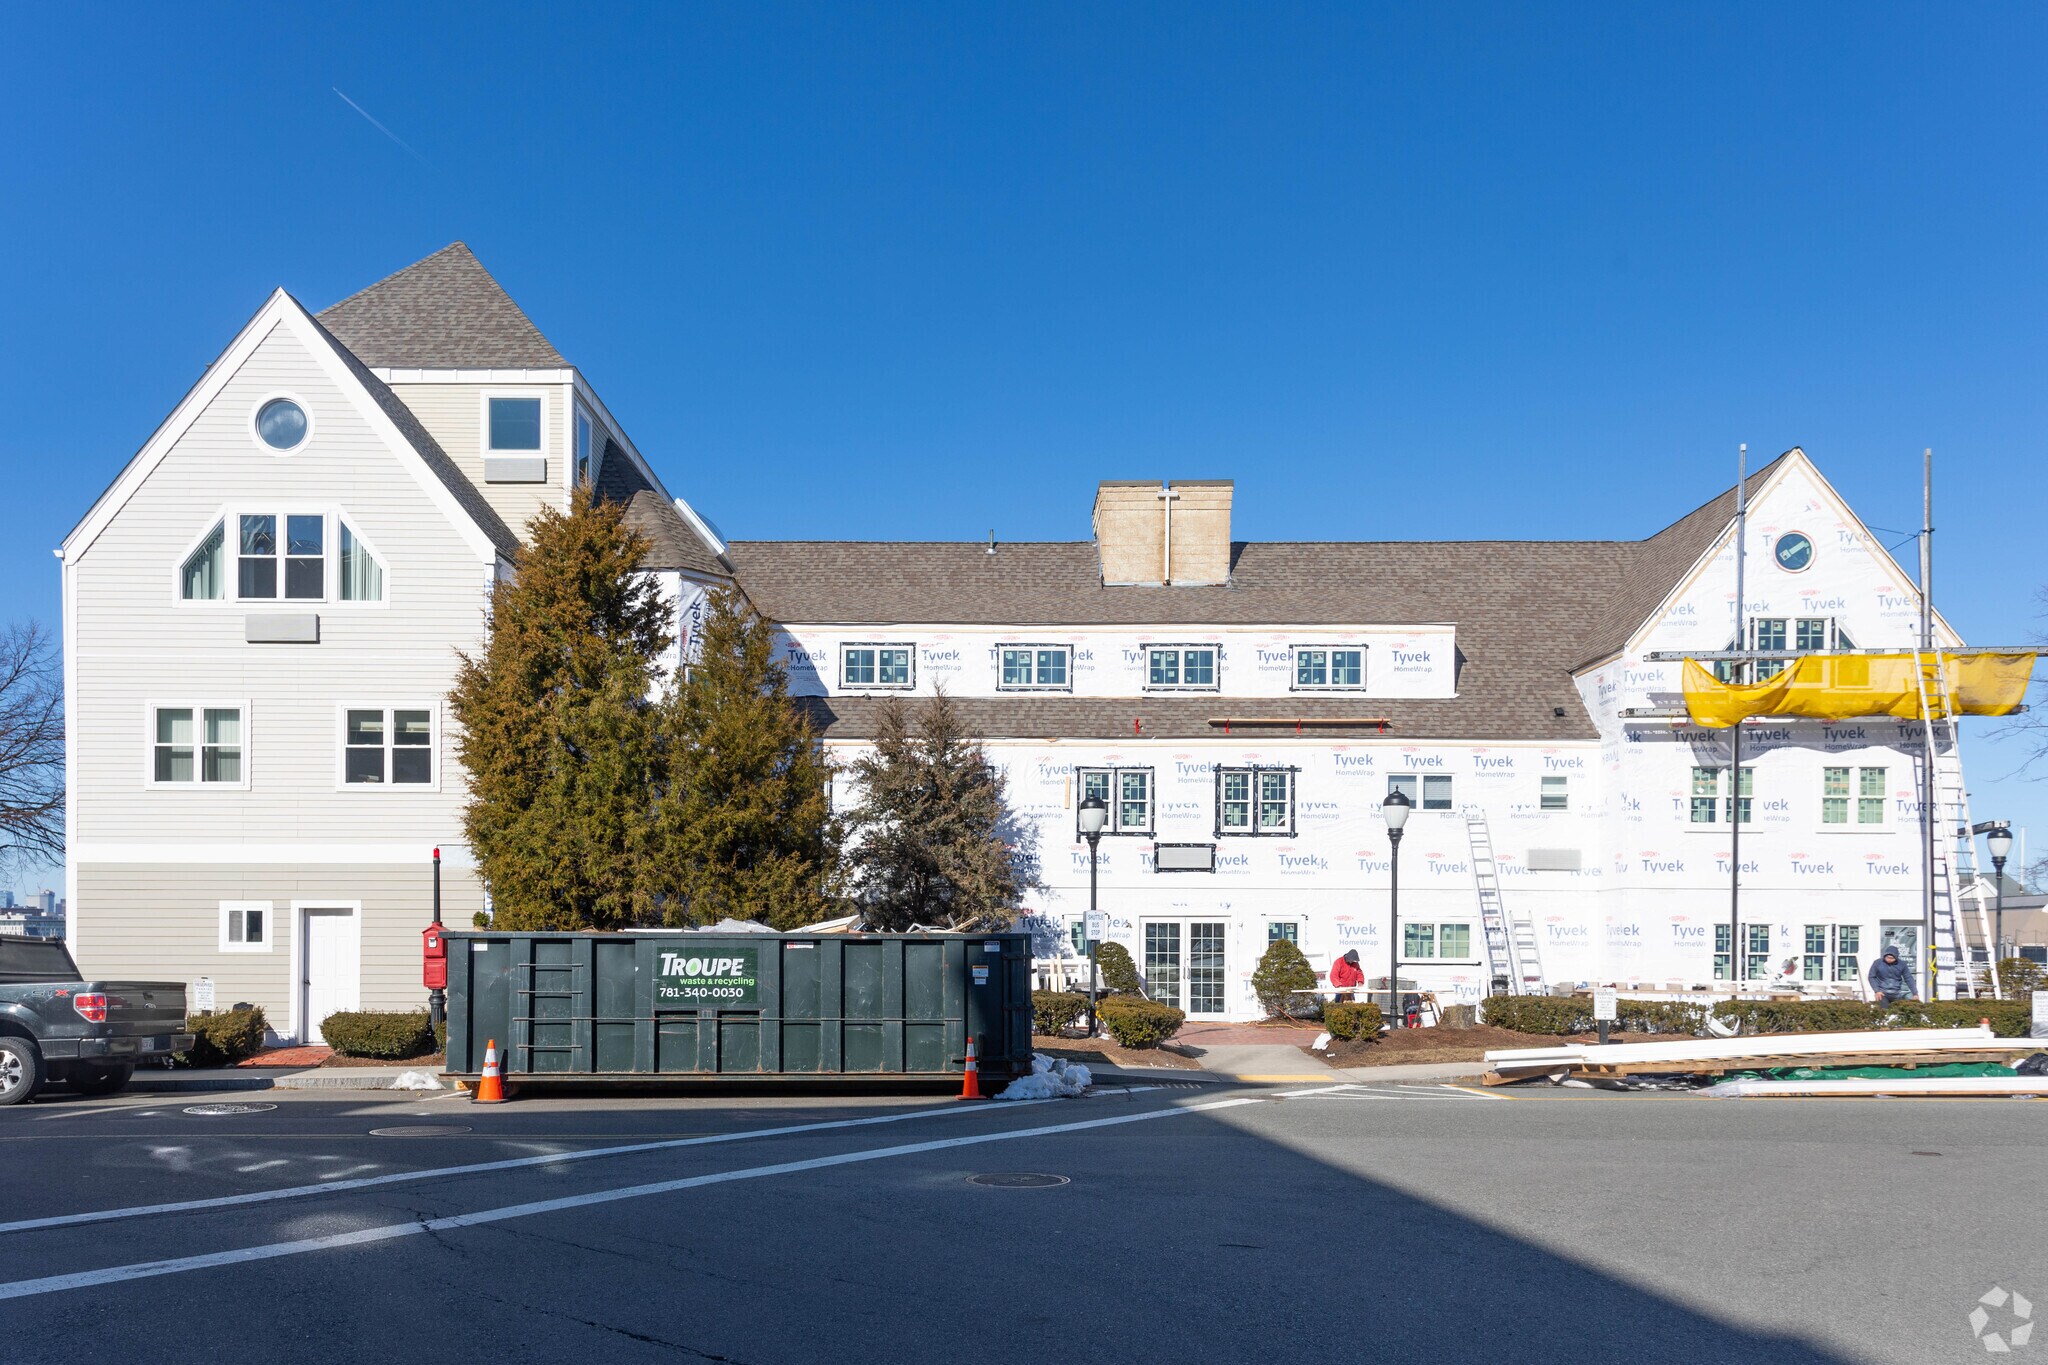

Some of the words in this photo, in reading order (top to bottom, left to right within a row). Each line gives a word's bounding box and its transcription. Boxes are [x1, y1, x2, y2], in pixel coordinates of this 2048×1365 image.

[1727, 599, 1770, 613] Tvek
[1802, 597, 1845, 613] Tyvek
[689, 601, 701, 645] Tyvek
[788, 649, 826, 664] Tyvek
[922, 649, 960, 663] Tyvek
[1392, 651, 1431, 665] Tyvek
[1624, 669, 1665, 686] Tyvek
[1625, 685, 1667, 693] HomeWrap
[1674, 729, 1716, 743] Tyvek
[1748, 728, 1791, 743] Tyvek
[1822, 726, 1866, 742] Tyvek
[1676, 745, 1718, 753] HomeWrap
[1750, 744, 1792, 752] HomeWrap
[1825, 743, 1867, 751] HomeWrap
[1333, 753, 1373, 767] Tyvek
[1403, 754, 1443, 769] Tyvek
[1473, 755, 1514, 770] Tyvek
[1544, 756, 1584, 771] Tyvek
[1176, 761, 1214, 774] Tyvek
[1301, 812, 1340, 820] HomeWrap
[1279, 854, 1318, 867] Tyvek
[1357, 858, 1391, 872] Tyve
[1428, 860, 1467, 874] Tyvek
[1642, 859, 1684, 873] Tyvek
[1791, 861, 1834, 875] Tyvek
[1866, 862, 1909, 875] Tyvek
[1336, 923, 1377, 938] Tyvek
[1547, 924, 1588, 937] Tyvek
[1672, 924, 1705, 939] Tyve
[661, 953, 744, 976] TROUPE
[714, 977, 755, 986] recycling
[660, 988, 744, 997] 781-340-0030
